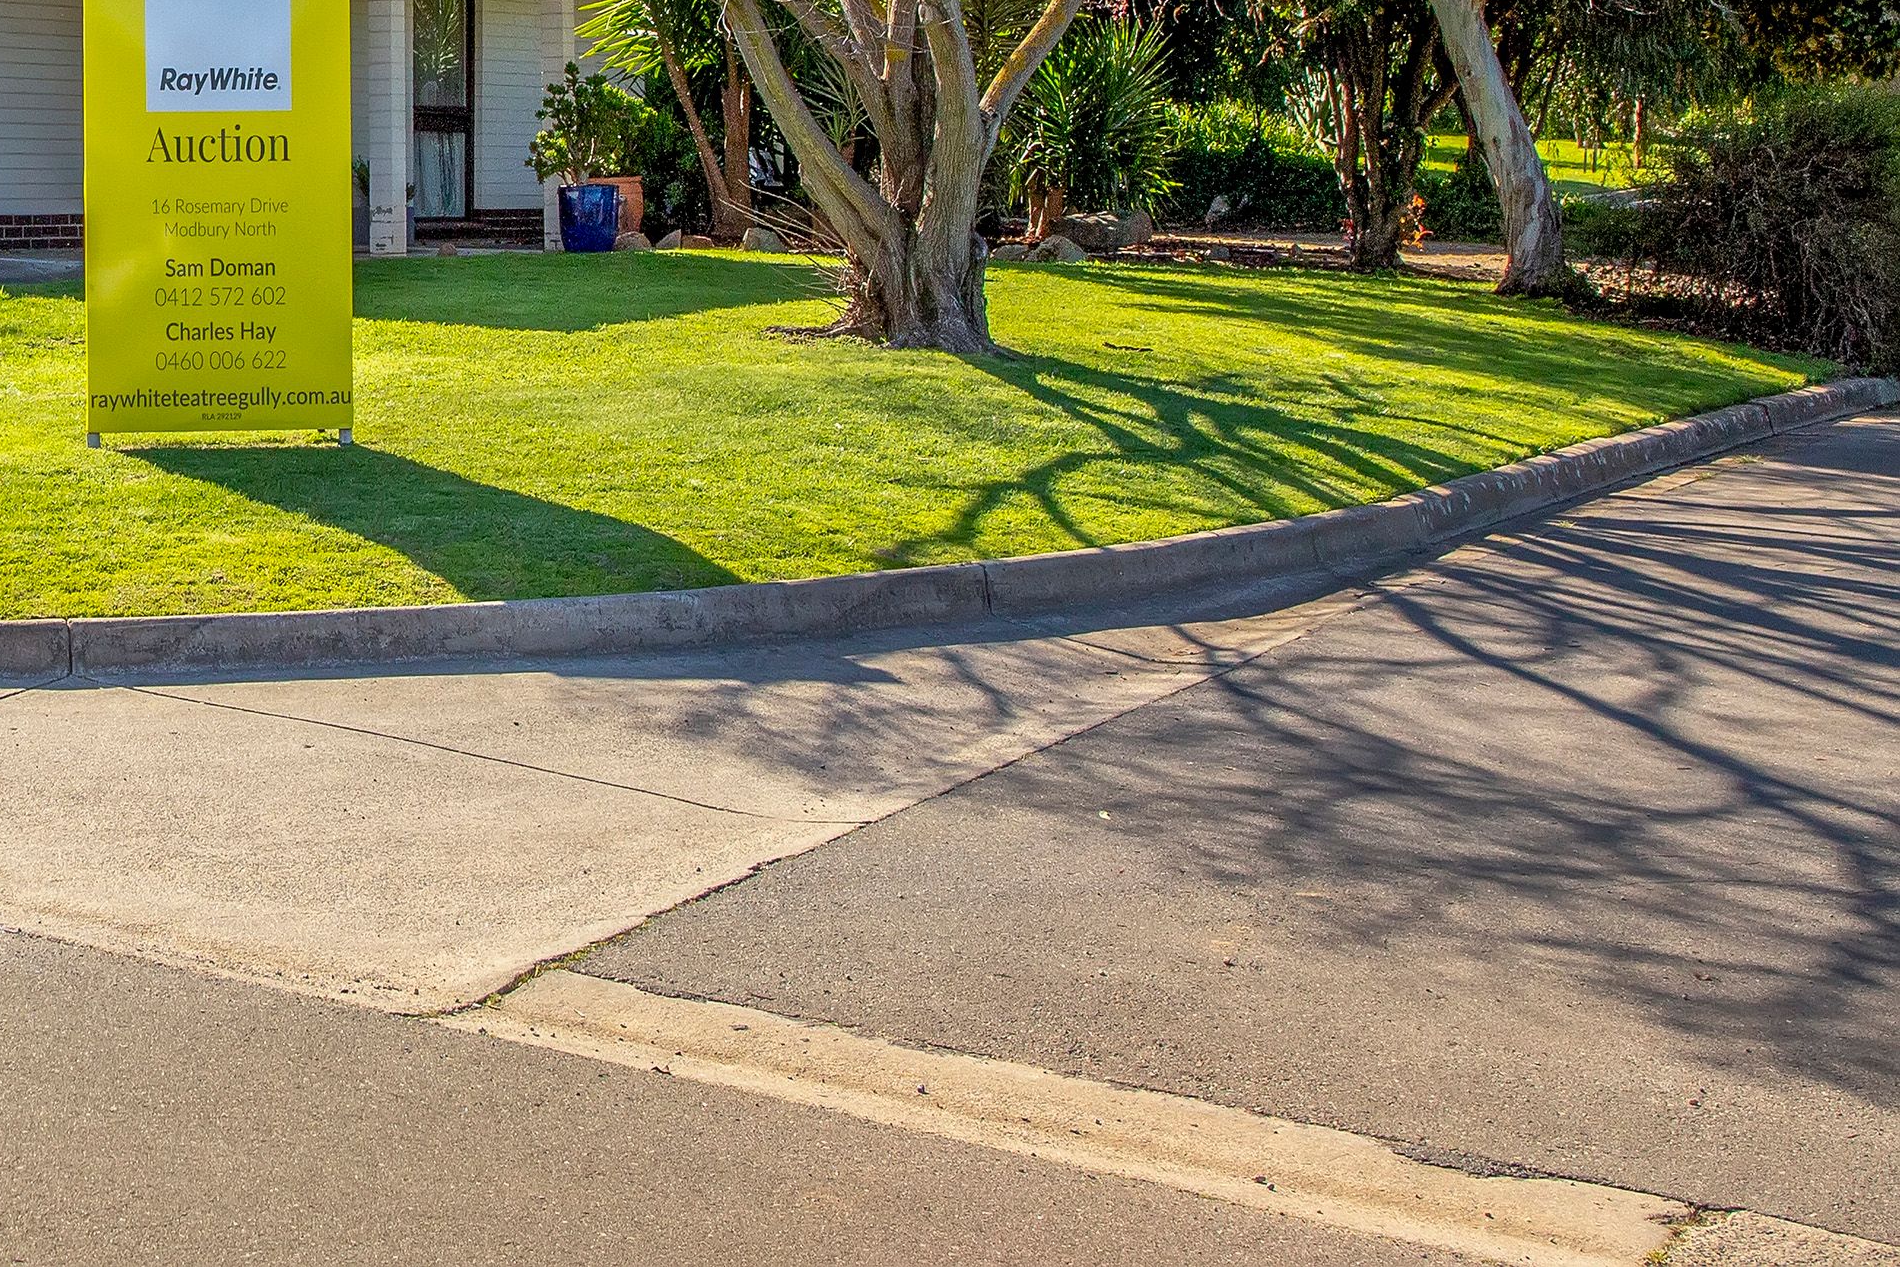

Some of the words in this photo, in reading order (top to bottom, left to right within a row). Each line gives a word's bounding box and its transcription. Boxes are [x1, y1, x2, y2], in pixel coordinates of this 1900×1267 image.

[146, 124, 290, 162] Auction
[152, 199, 170, 214] 16
[175, 198, 245, 216] Rosemary
[250, 197, 289, 213] Drive
[164, 222, 231, 239] Modbury
[235, 221, 276, 237] North
[165, 258, 203, 277] Sam
[210, 258, 276, 276] Doman
[155, 287, 203, 306] 0412
[210, 287, 244, 306] 572
[251, 286, 286, 306] 602
[166, 322, 234, 341] Charles
[240, 322, 277, 343] Hay
[155, 351, 204, 370] 0460
[209, 351, 245, 370] 006
[252, 350, 287, 369] 622
[90, 387, 351, 411] raywhiteteatreegully.com.au
